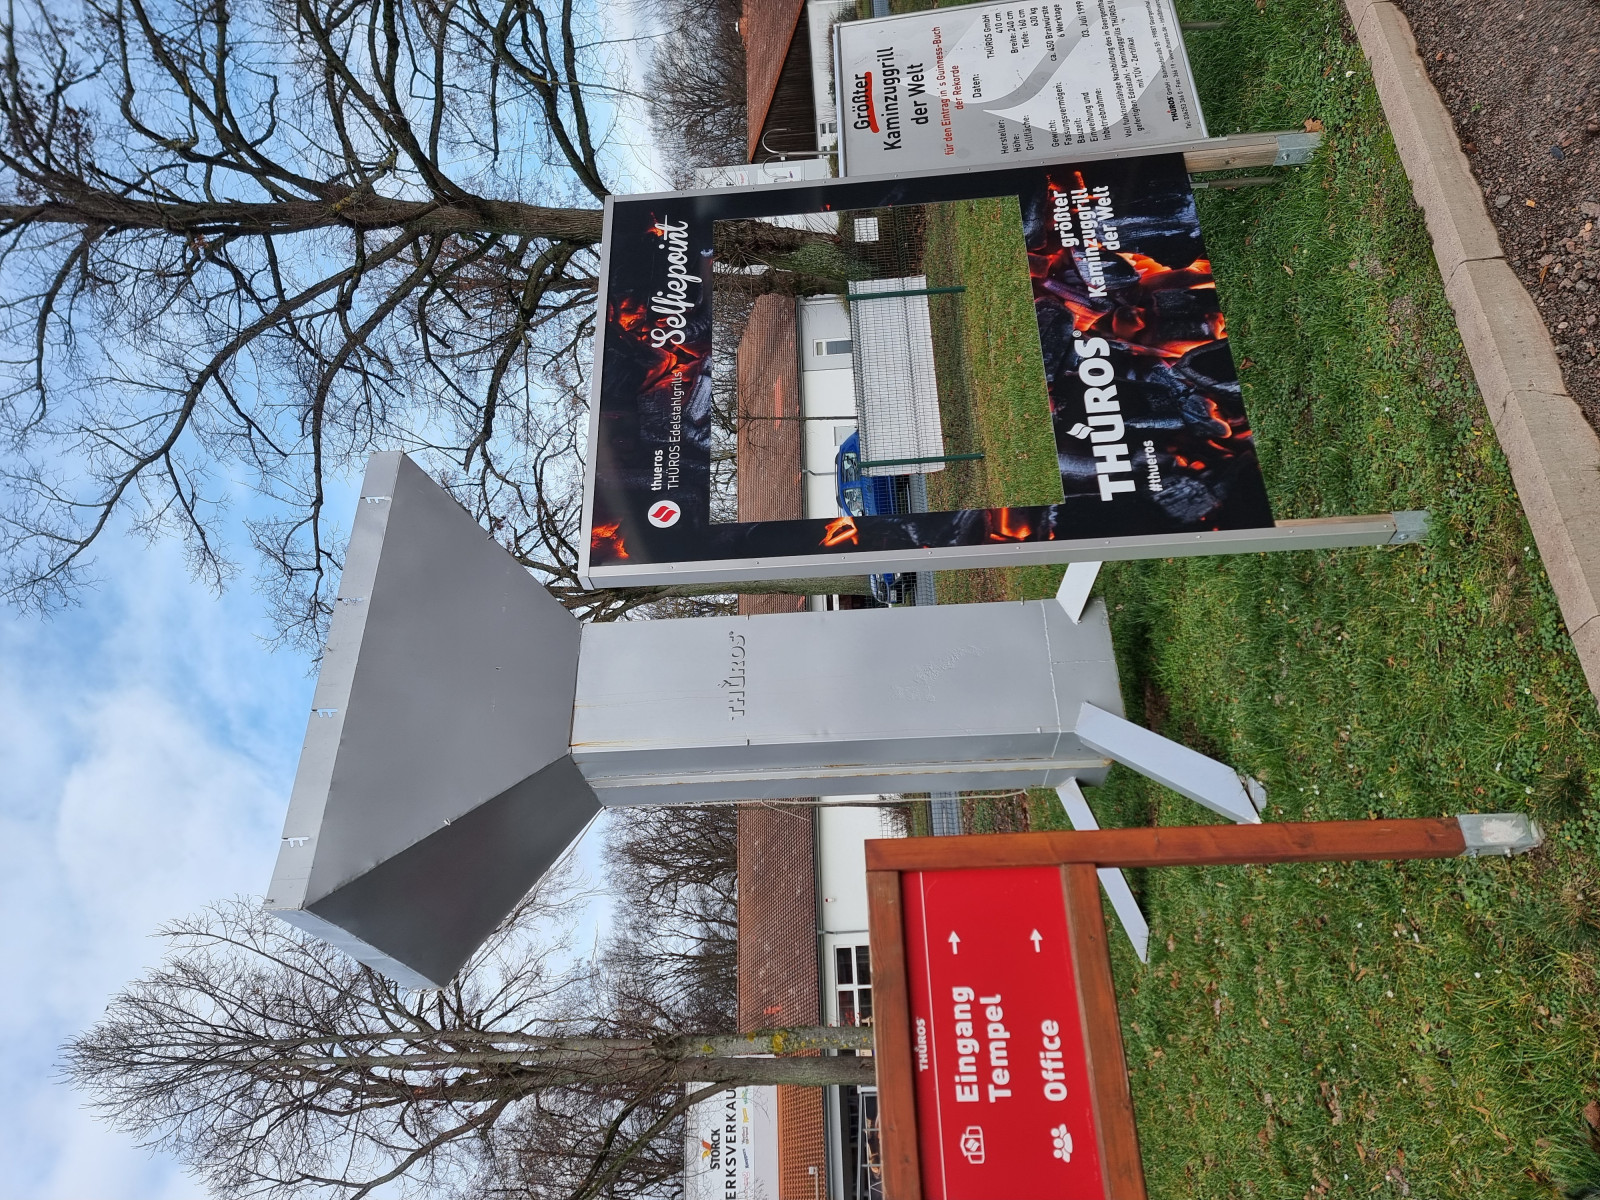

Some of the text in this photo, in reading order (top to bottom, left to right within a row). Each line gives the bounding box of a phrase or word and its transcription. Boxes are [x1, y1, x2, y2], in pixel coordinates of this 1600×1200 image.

[995, 13, 1001, 21] cm
[1006, 10, 1019, 53] Breite: 240 cm
[1018, 9, 1030, 48] Tiefe: 160 cm
[1030, 16, 1039, 26] 630
[1041, 6, 1053, 39] Bratwürste
[1054, 4, 1064, 33] Werktage
[1076, 1, 1090, 37] 03. Juli 1999
[1097, 0, 1109, 29] Georgentha
[1108, 5, 1119, 27] THÜROS
[932, 27, 945, 80] Guinness-Buch
[982, 14, 995, 59] THÜROS GmbH
[1046, 41, 1056, 51] 450
[1105, 37, 1113, 46] des
[1114, 28, 1129, 68] Kaminzuggrills
[1127, 37, 1139, 62] Zertifikat
[1108, 47, 1120, 81] Nachbildung
[1133, 67, 1144, 78] TÜV
[1136, 79, 1145, 88] mit
[852, 74, 870, 130] Größter
[877, 47, 902, 150] Kaminzuggrill
[907, 63, 928, 124] der Welt
[950, 65, 963, 110] der Rekorde
[972, 74, 982, 98] Daten:
[1116, 82, 1130, 125] funktionsfähige
[1125, 73, 1135, 98] Edelstahl
[940, 98, 951, 126] Eintrag
[1056, 82, 1072, 145] Fassungsvermögen:
[1074, 118, 1085, 143] Bauzeit:
[1081, 92, 1098, 142] Einweihung und
[1095, 88, 1111, 140] Inbetriebnahme:
[1124, 126, 1133, 137] Voll
[1131, 100, 1145, 131] gefertigten
[944, 128, 953, 142] den
[944, 144, 954, 155] für
[998, 120, 1009, 154] Hersteller:
[1022, 115, 1034, 150] Grillfläche:
[1048, 120, 1060, 147] Gewicht:
[1053, 191, 1080, 247] größter
[1092, 186, 1121, 250] der Welt
[1071, 187, 1108, 297] Kaminzuggrill
[650, 214, 703, 348] Selfiepoint
[665, 371, 684, 490] THÜROS Edelstahlgrills
[650, 450, 664, 491] thueros
[1142, 440, 1163, 492] #thueros
[952, 986, 980, 1102] Eingang
[980, 994, 1012, 1103] Tempel
[1040, 1020, 1068, 1101] Office
[710, 1129, 720, 1170] STORCK
[726, 1090, 736, 1200] ERKSVERKAU
